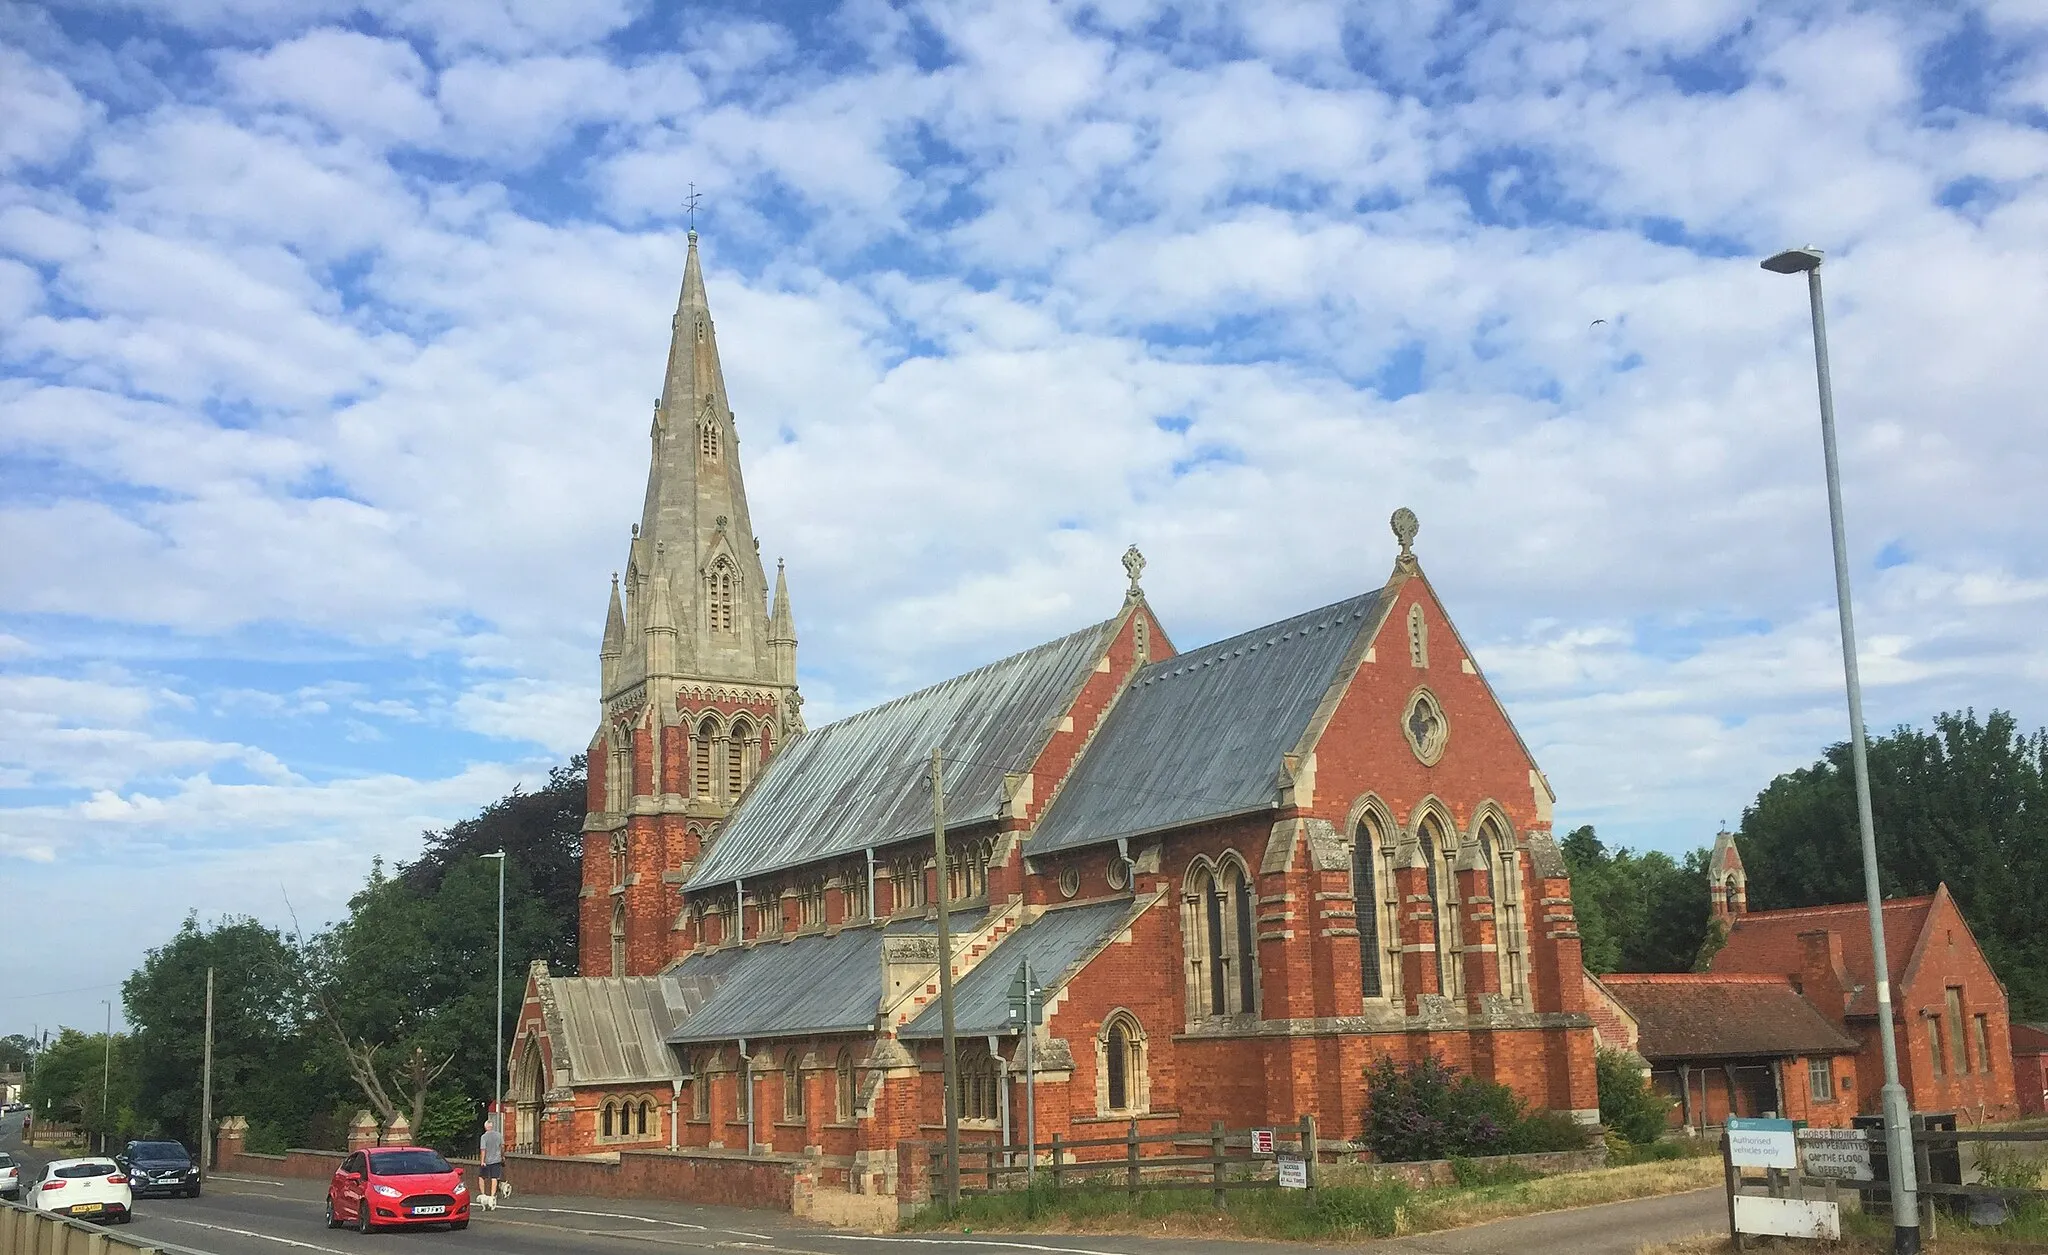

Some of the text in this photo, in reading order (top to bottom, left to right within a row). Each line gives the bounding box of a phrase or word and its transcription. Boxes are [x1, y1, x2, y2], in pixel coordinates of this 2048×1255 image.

[1803, 1130, 1857, 1139] HORSE RIDING
[1733, 1136, 1771, 1145] Authorised
[1827, 1142, 1868, 1151] PERMITTED
[1763, 1147, 1779, 1156] only
[1823, 1154, 1836, 1162] THE
[1838, 1154, 1863, 1162] FLOOD
[1818, 1165, 1857, 1175] DEFENCES
